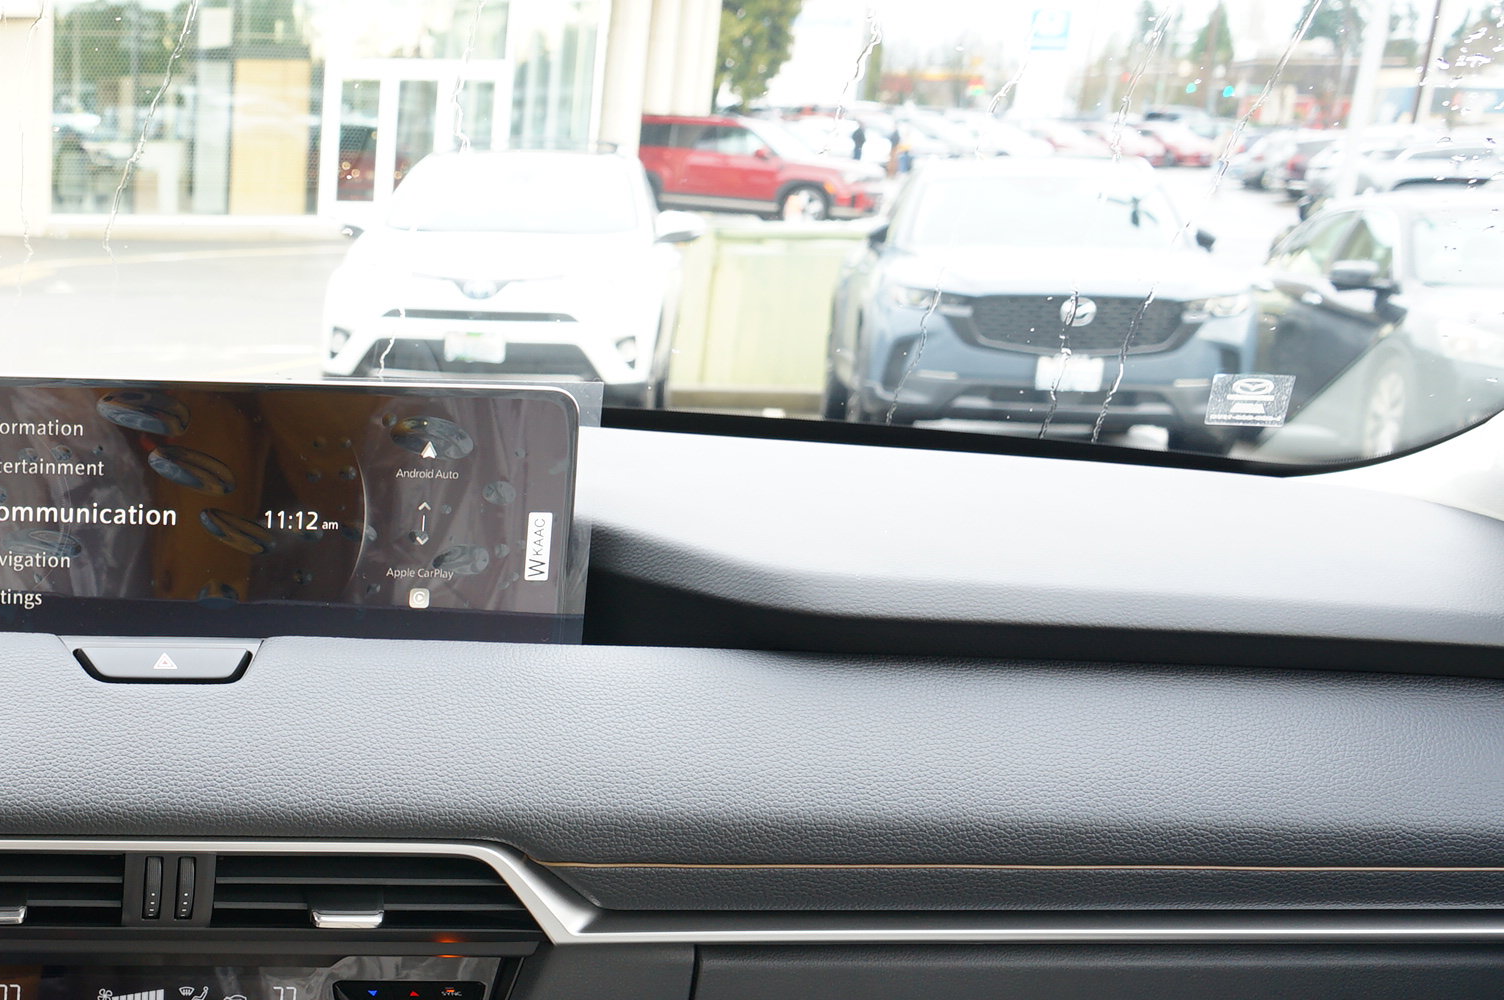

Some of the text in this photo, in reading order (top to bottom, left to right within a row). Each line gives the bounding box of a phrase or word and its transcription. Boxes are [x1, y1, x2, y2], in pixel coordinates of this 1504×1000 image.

[396, 469, 459, 480] Android Auto
[264, 509, 340, 533] 11:12 am
[386, 567, 454, 581] Apple CarPlay
